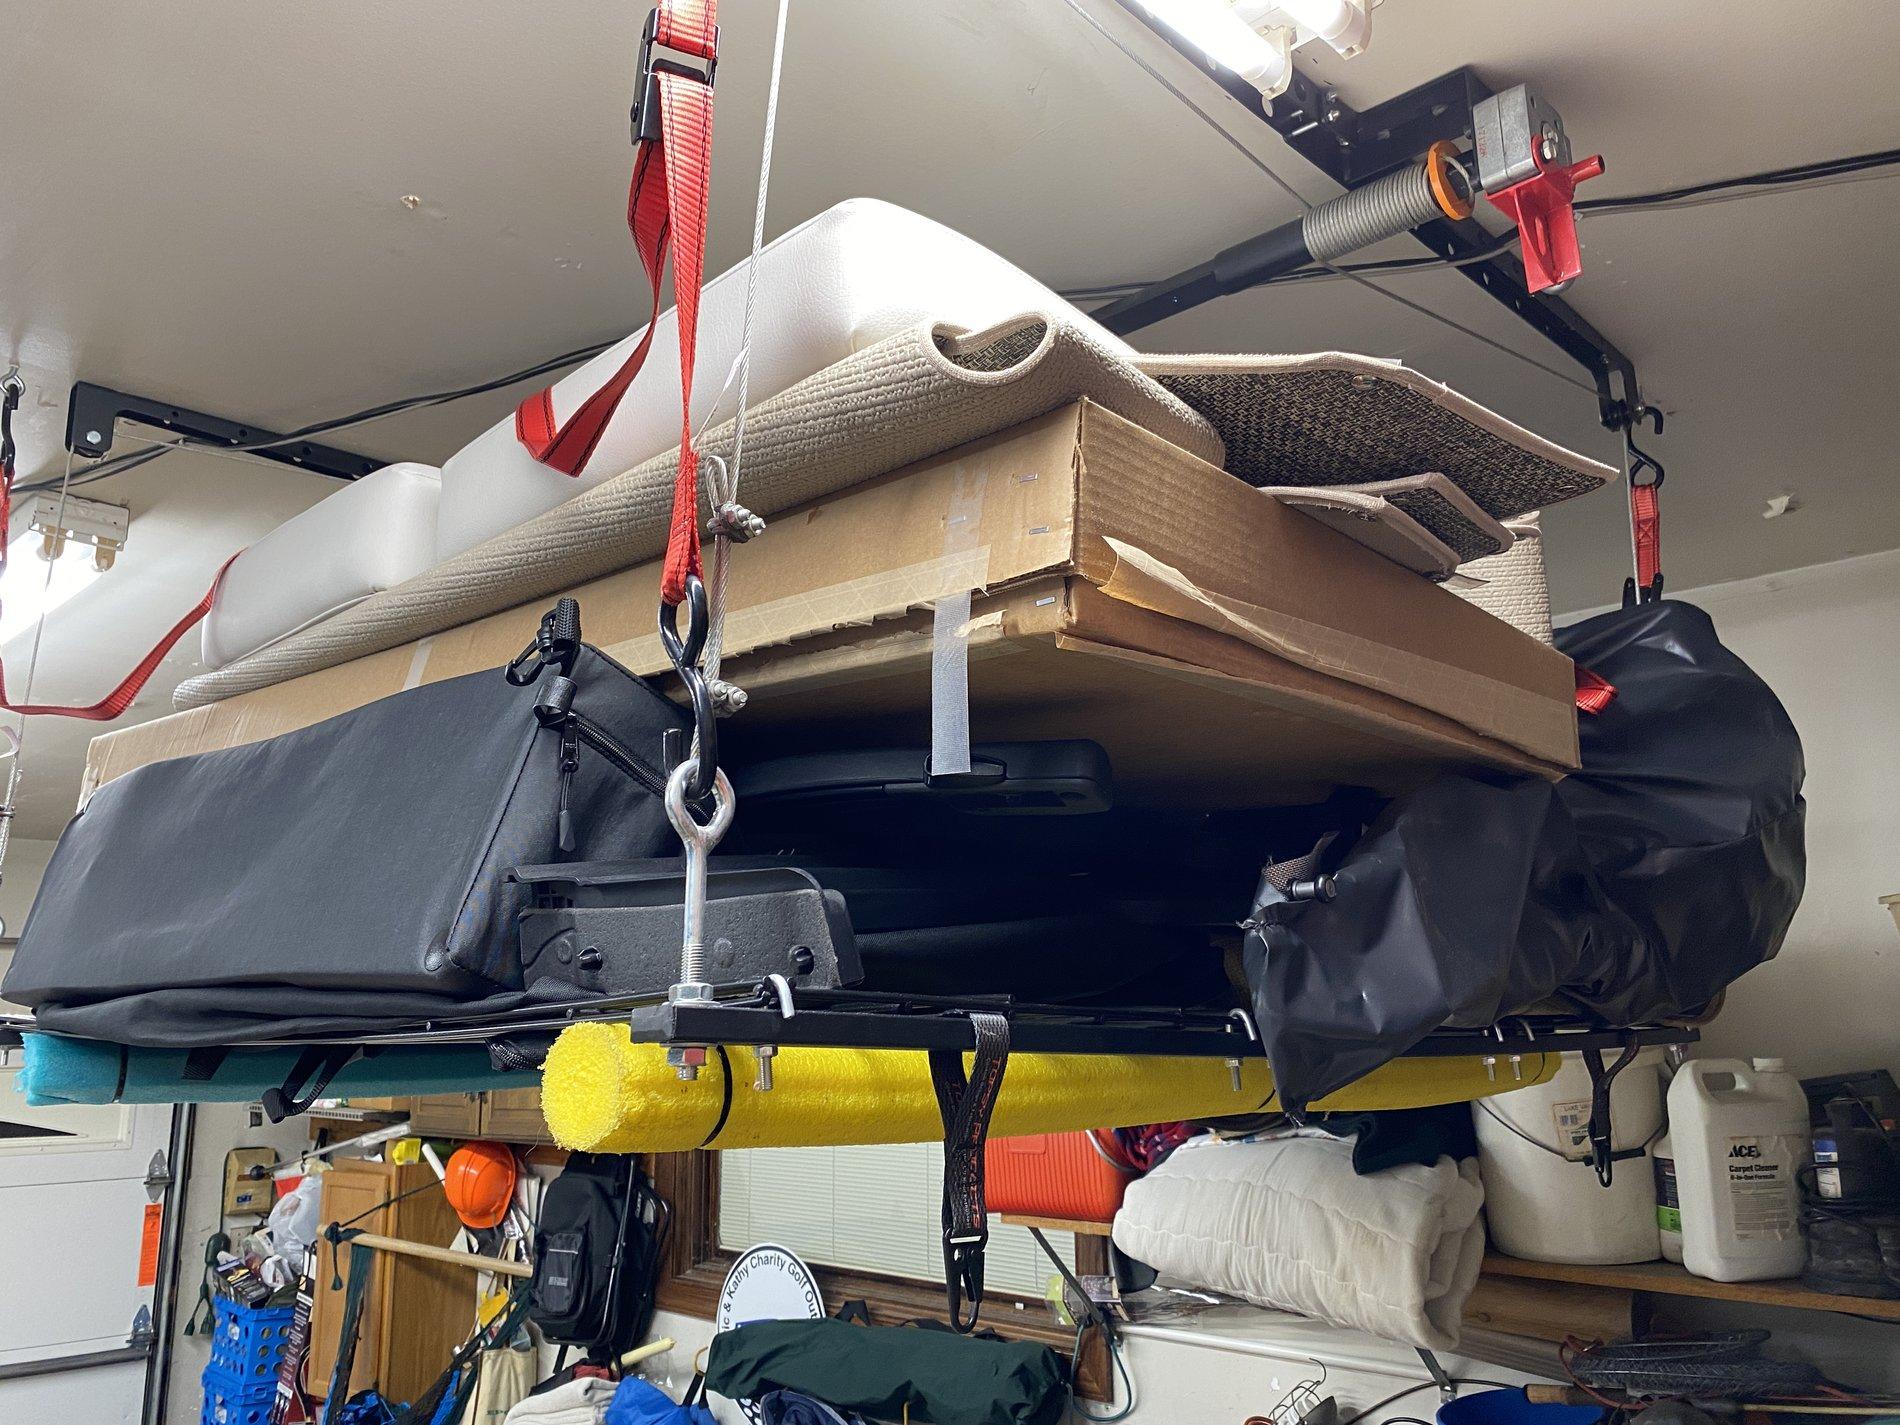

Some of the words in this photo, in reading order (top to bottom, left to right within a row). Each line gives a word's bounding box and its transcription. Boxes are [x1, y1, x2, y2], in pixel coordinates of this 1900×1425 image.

[1728, 1144, 1761, 1158] ACE
[1729, 1164, 1754, 1173] Carpet
[1754, 1164, 1779, 1172] Cleaner
[750, 1253, 786, 1272] Charity
[726, 1263, 749, 1300] Kathy
[787, 1262, 808, 1289] Golf
[723, 1302, 731, 1312] &
[722, 1317, 730, 1332] ic
